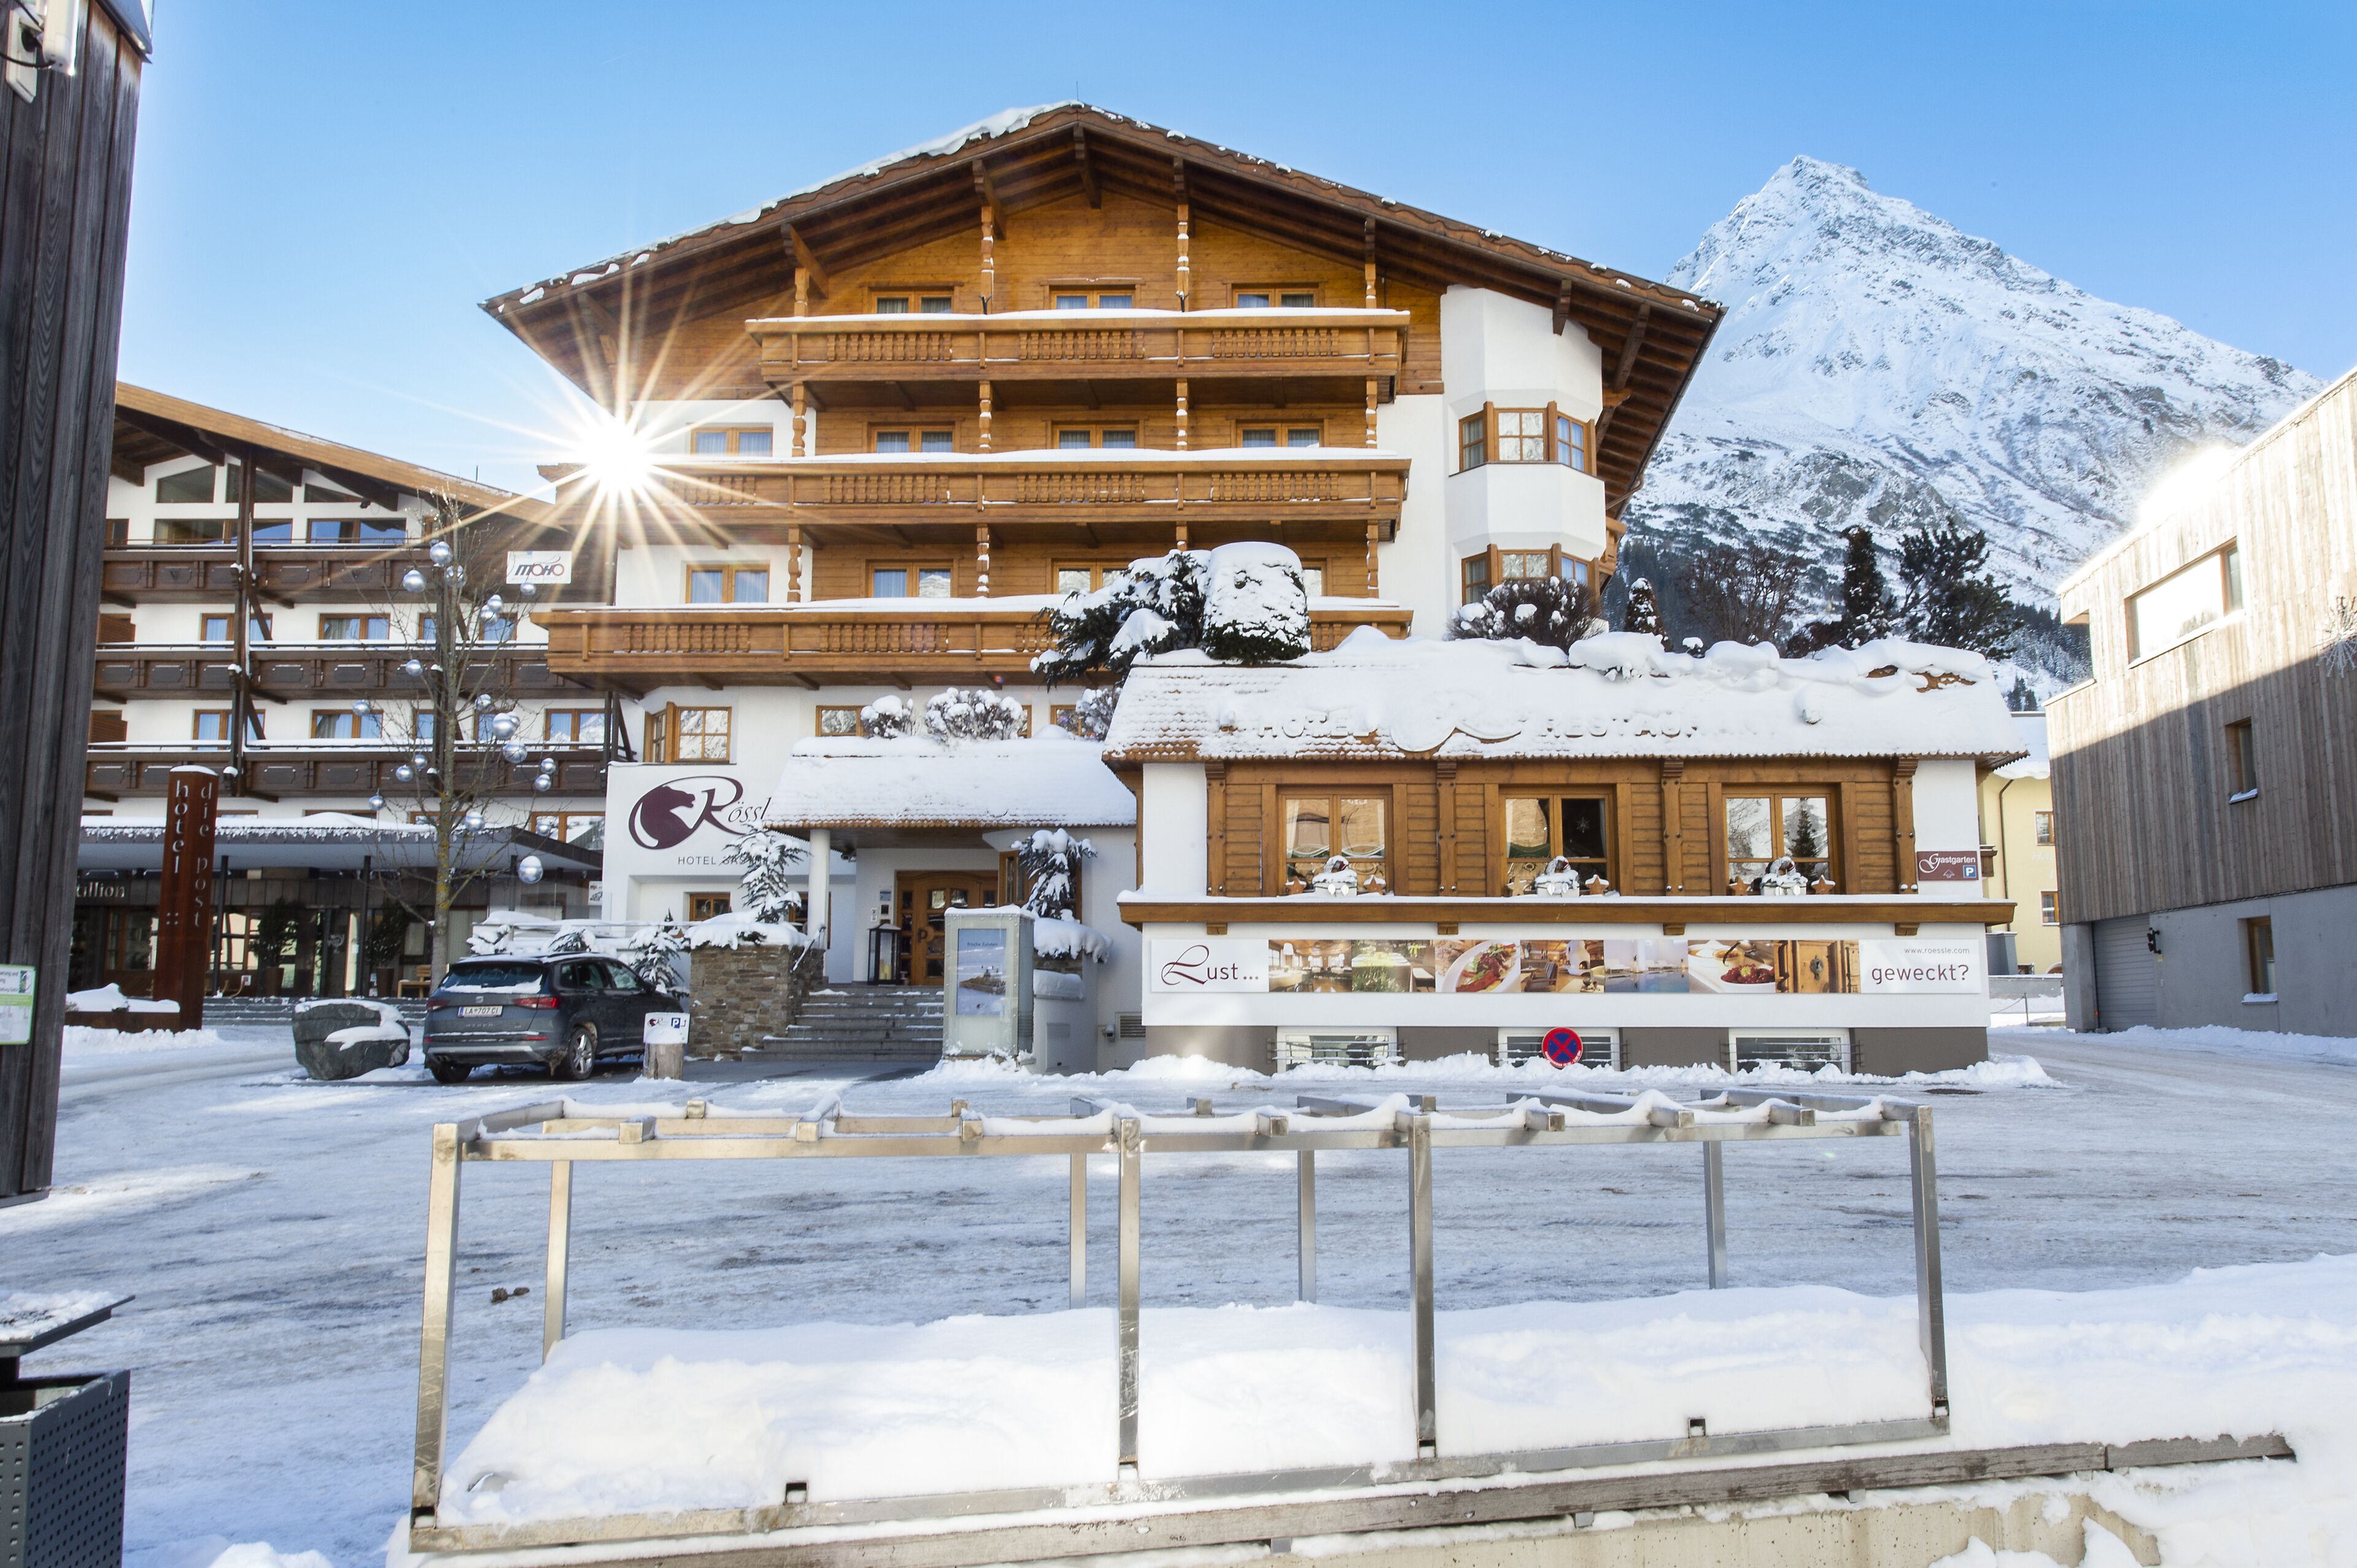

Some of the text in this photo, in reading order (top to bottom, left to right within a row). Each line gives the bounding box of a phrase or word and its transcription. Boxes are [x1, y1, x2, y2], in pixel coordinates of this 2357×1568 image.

[172, 779, 189, 874] hotel
[195, 782, 212, 928] die post
[678, 856, 716, 865] HOTEL
[1919, 853, 1976, 873] Gastgarten
[1965, 867, 1975, 876] P
[1871, 964, 1969, 985] geweckt?
